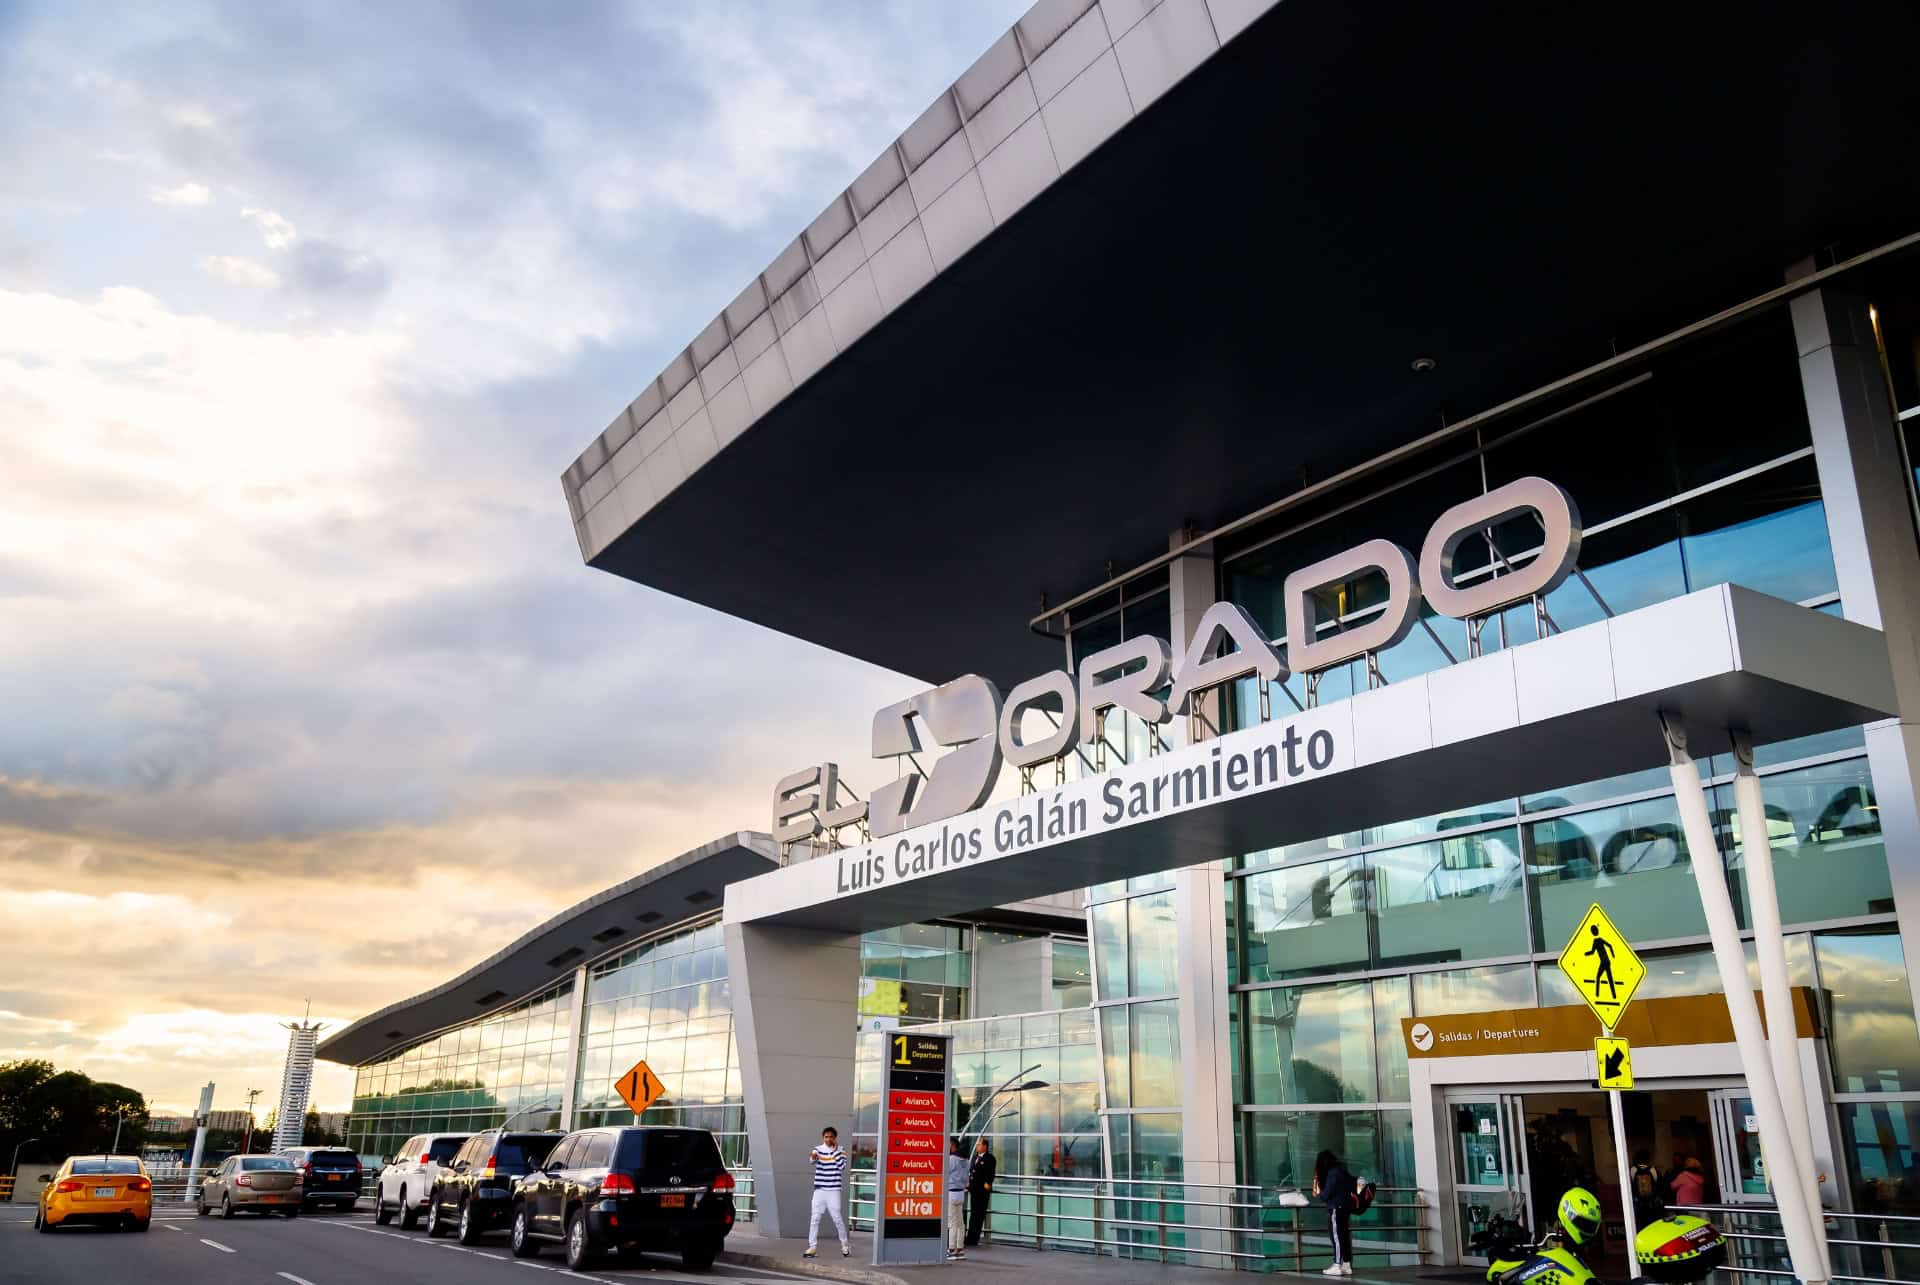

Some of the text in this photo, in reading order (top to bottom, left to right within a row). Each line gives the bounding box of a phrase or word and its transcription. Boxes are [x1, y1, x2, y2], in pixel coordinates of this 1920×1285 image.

[772, 476, 1582, 842] EL DORADO
[837, 724, 1335, 894] Luis Carlos Galán Sarmiento
[1439, 1031, 1472, 1042] Salidas
[1483, 1028, 1539, 1041] Departures
[895, 1036, 911, 1065] 1
[905, 1097, 931, 1106] Avianca
[904, 1117, 930, 1127] Avianca
[904, 1138, 930, 1148] Avianca
[902, 1160, 928, 1168] Avianca
[895, 1177, 934, 1194] ultra
[894, 1198, 933, 1216] ultra
